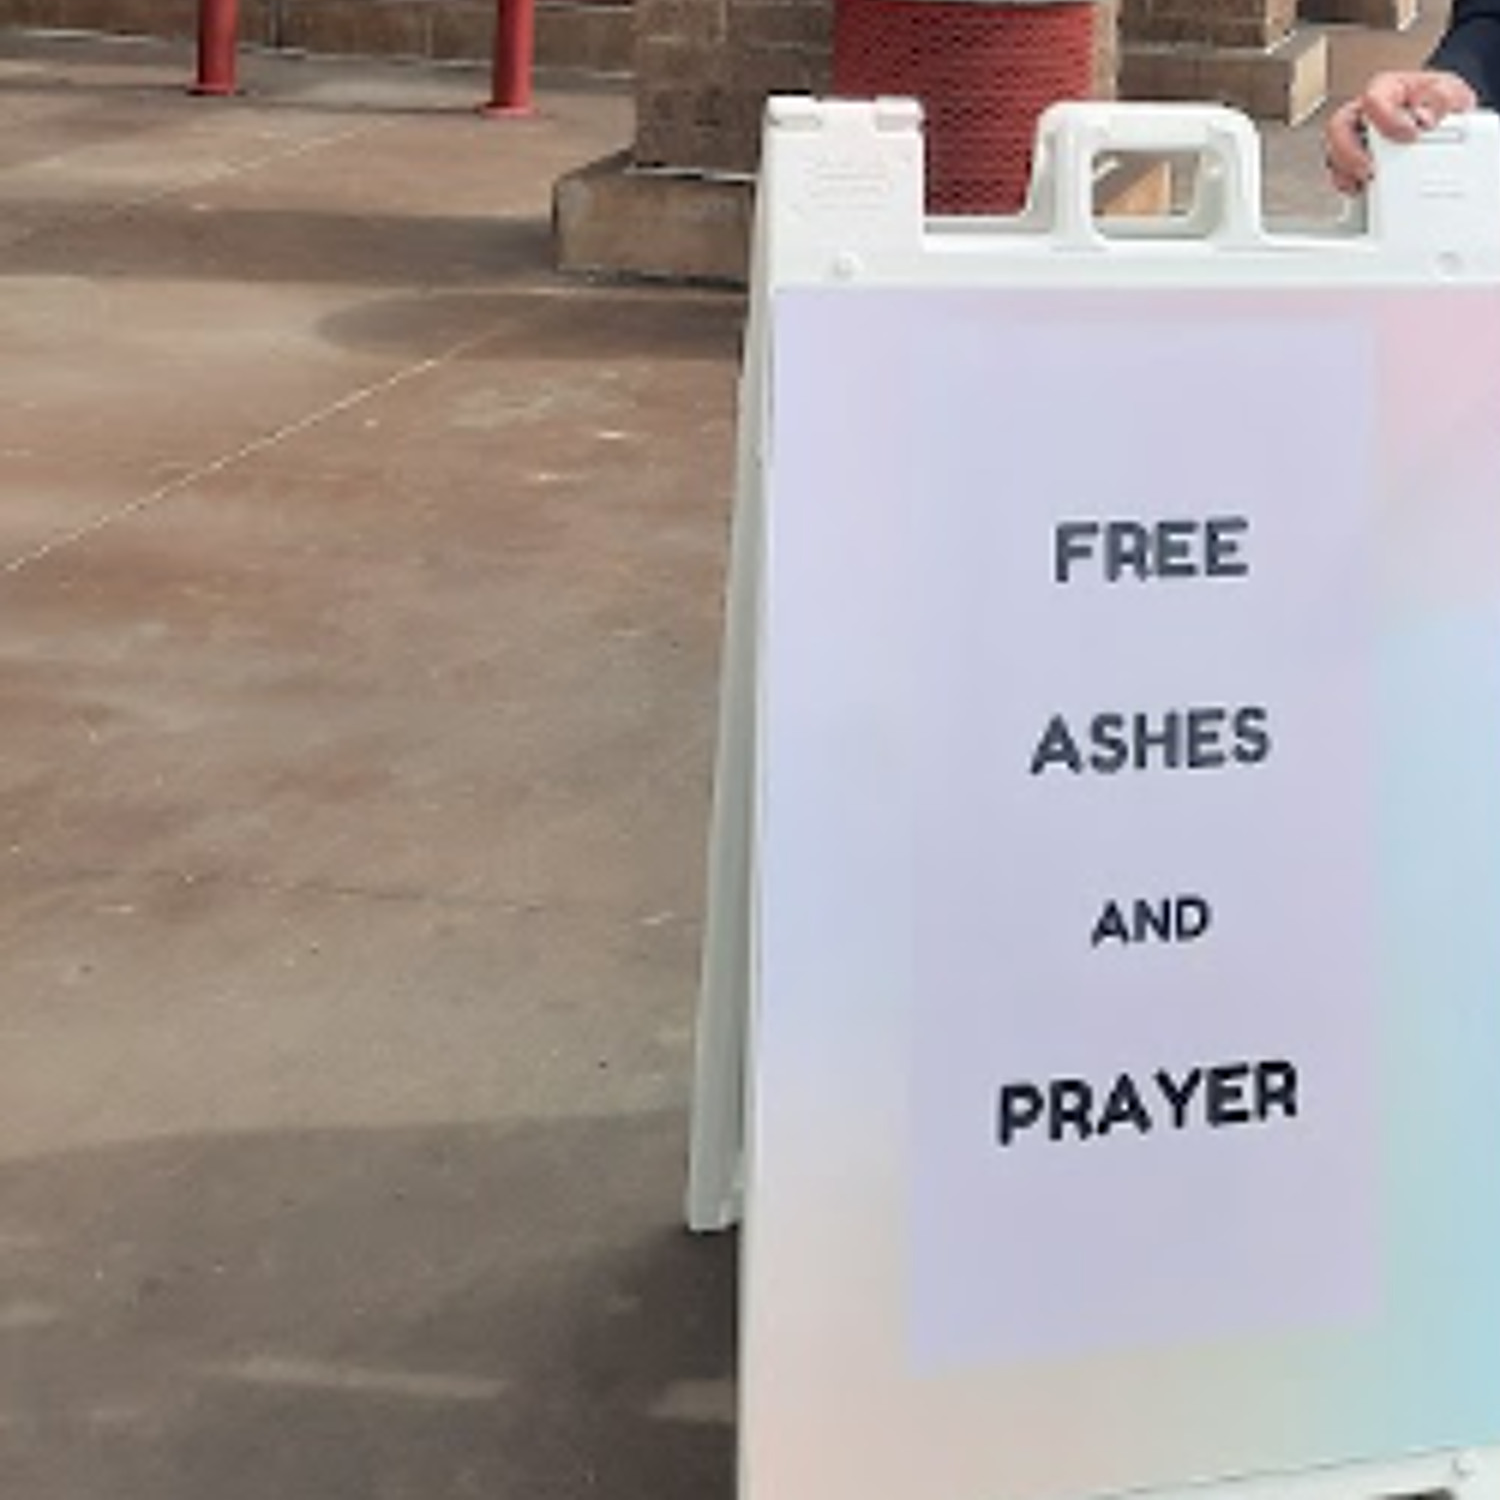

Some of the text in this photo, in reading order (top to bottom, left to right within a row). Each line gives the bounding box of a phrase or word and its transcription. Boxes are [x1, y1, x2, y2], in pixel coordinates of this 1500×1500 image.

[1053, 514, 1250, 585] FREE
[1029, 705, 1271, 777] ASHES
[1089, 894, 1212, 948] AND
[996, 1058, 1299, 1148] PRAYER
